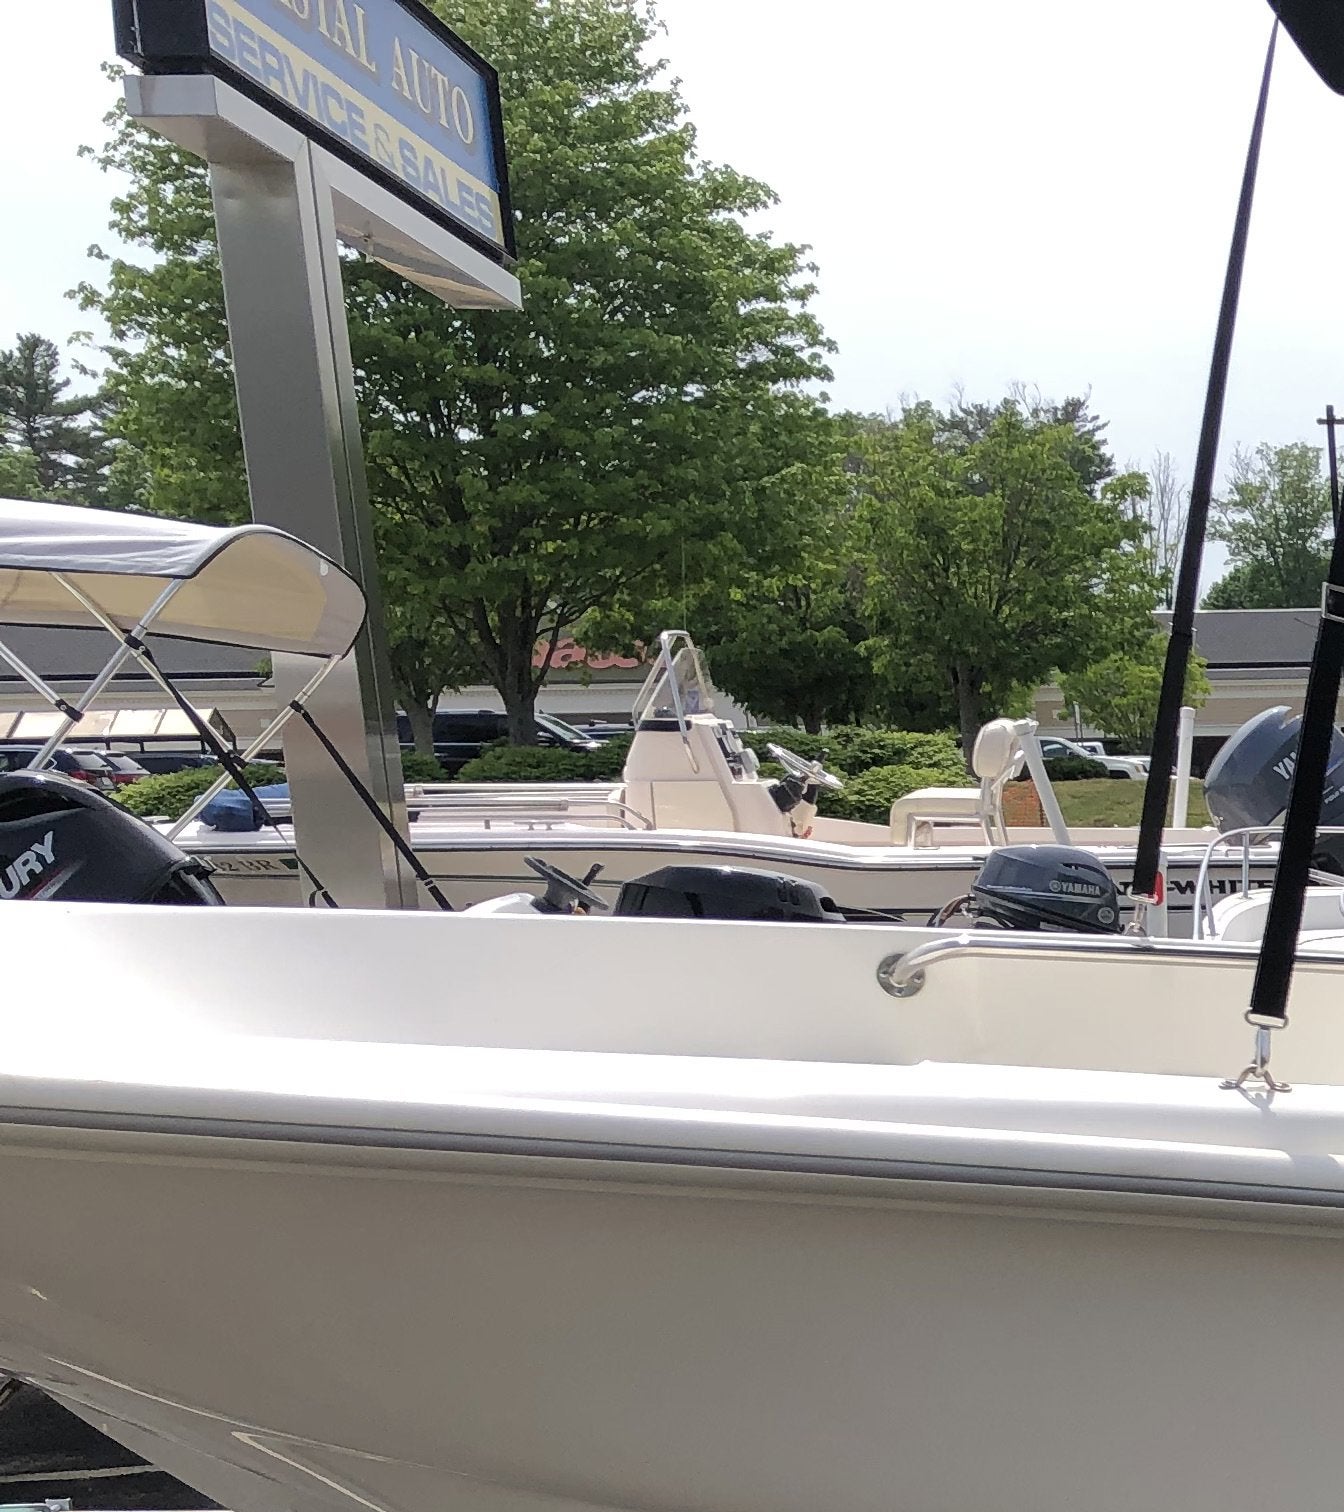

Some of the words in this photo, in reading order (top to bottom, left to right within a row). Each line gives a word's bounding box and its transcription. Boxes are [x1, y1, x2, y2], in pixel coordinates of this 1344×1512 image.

[206, 1, 369, 151] SERVICE
[373, 123, 401, 170] &
[400, 135, 497, 231] SALES
[391, 36, 475, 145] AUTO
[1061, 881, 1100, 896] YAMAHA
